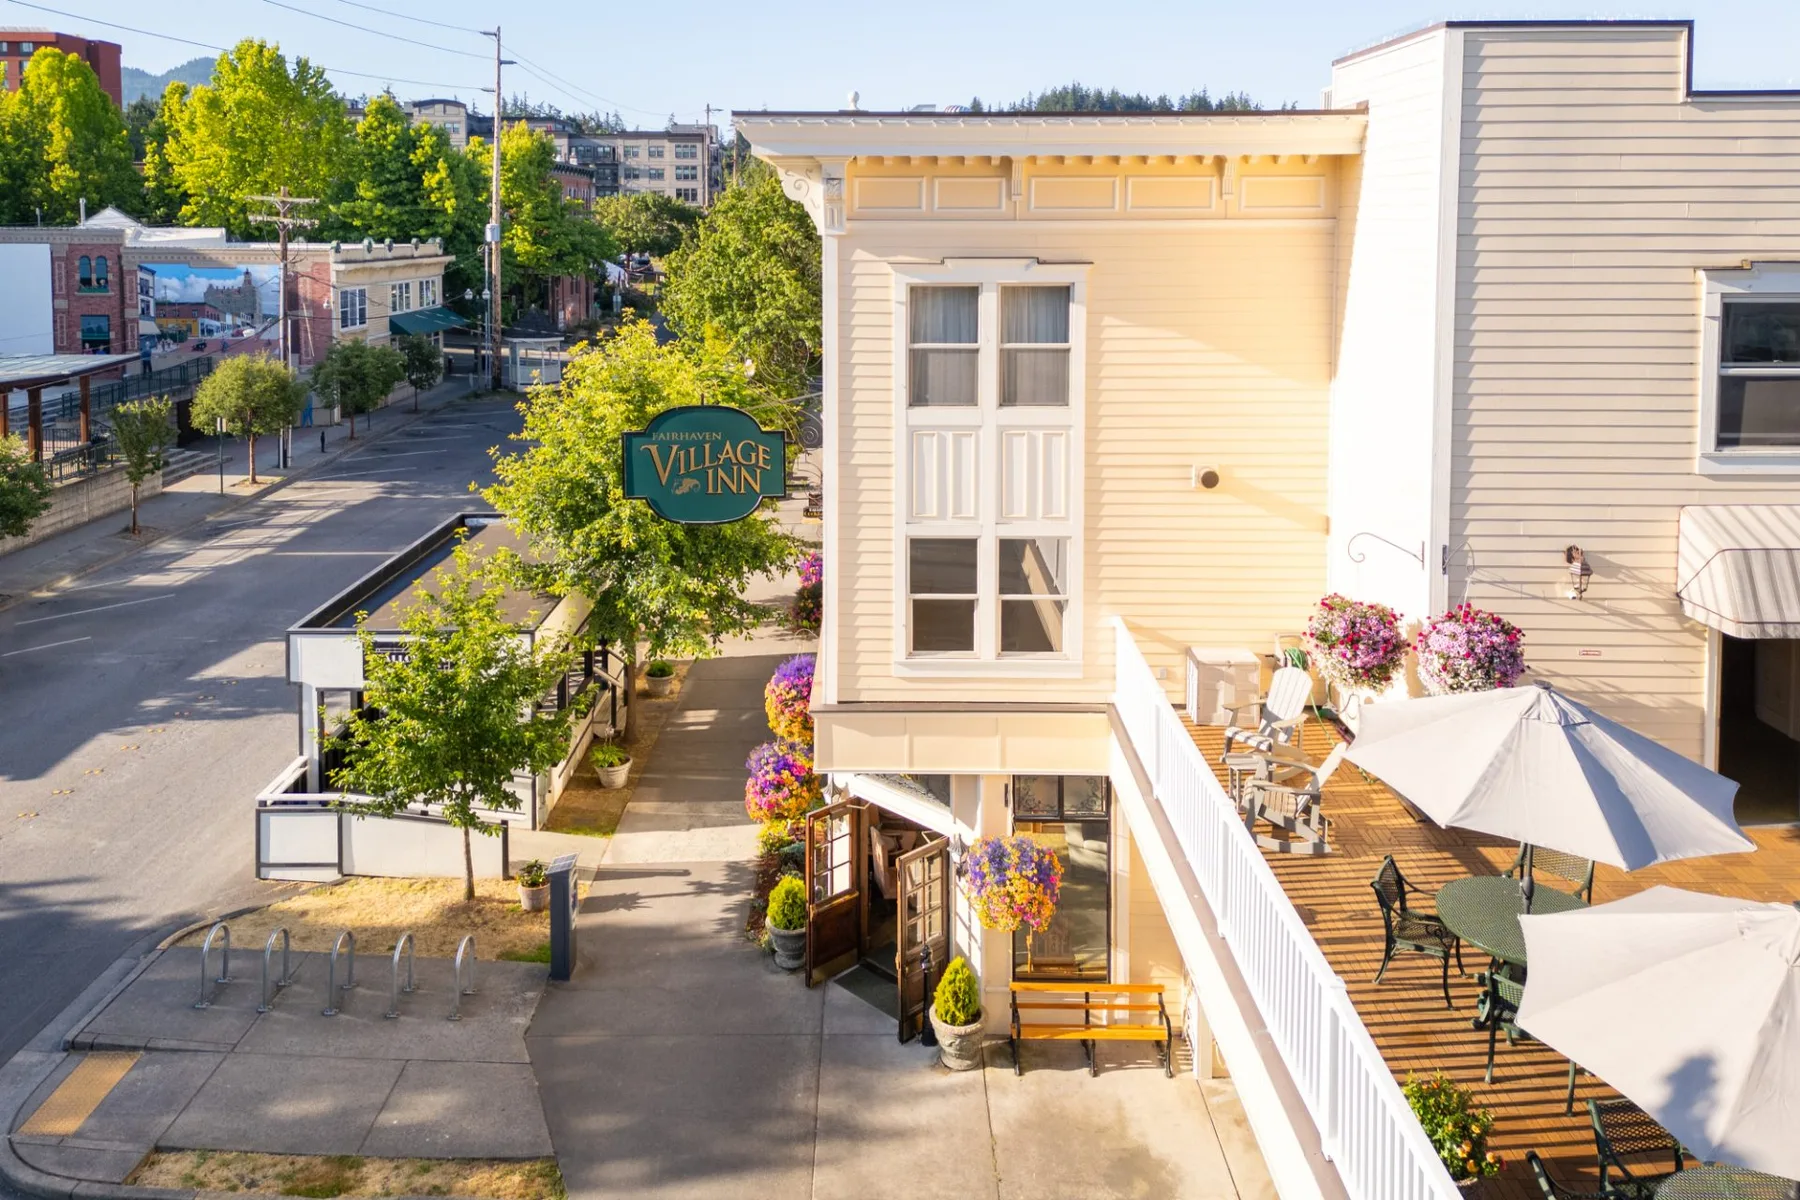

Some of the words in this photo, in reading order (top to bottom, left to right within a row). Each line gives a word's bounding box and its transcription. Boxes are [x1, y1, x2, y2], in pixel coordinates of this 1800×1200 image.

[652, 431, 722, 441] FAIRHAVEN
[640, 440, 771, 487] VILLAGE
[706, 465, 761, 494] INN
